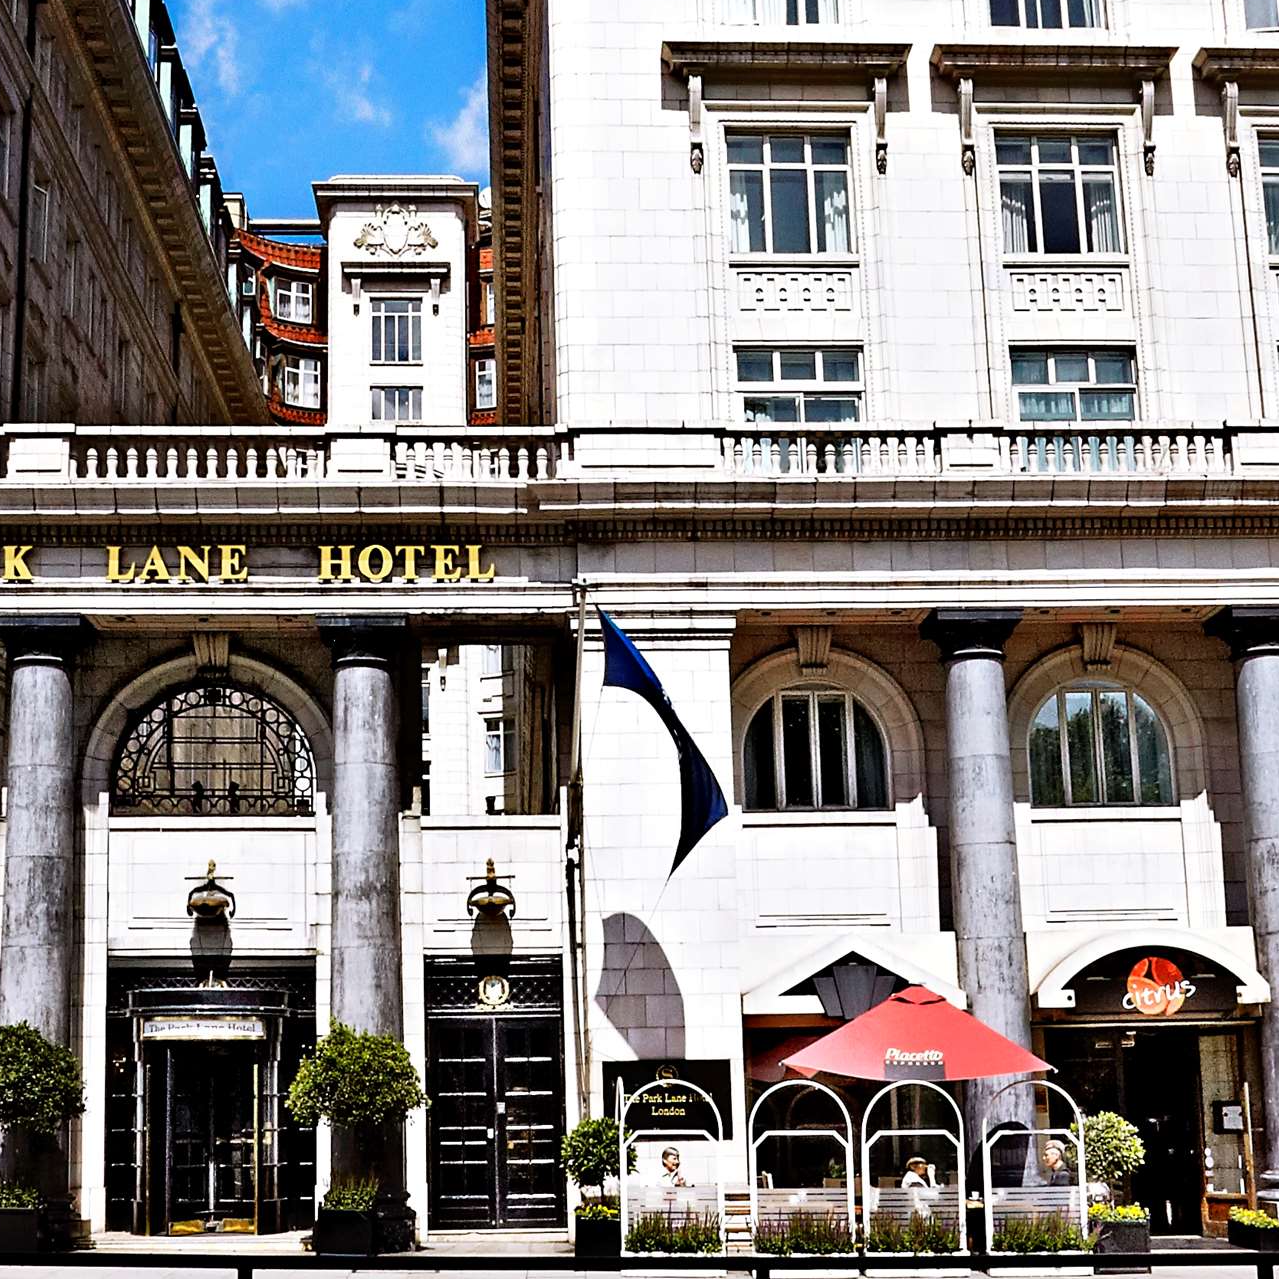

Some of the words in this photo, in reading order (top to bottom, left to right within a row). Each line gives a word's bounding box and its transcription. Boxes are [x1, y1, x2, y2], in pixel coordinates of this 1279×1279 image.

[106, 545, 248, 582] LANE
[318, 544, 495, 582] HOTEL
[1122, 980, 1196, 1010] citrus
[642, 1093, 662, 1103] Park
[665, 1093, 687, 1103] Lane
[651, 1106, 686, 1116] London
